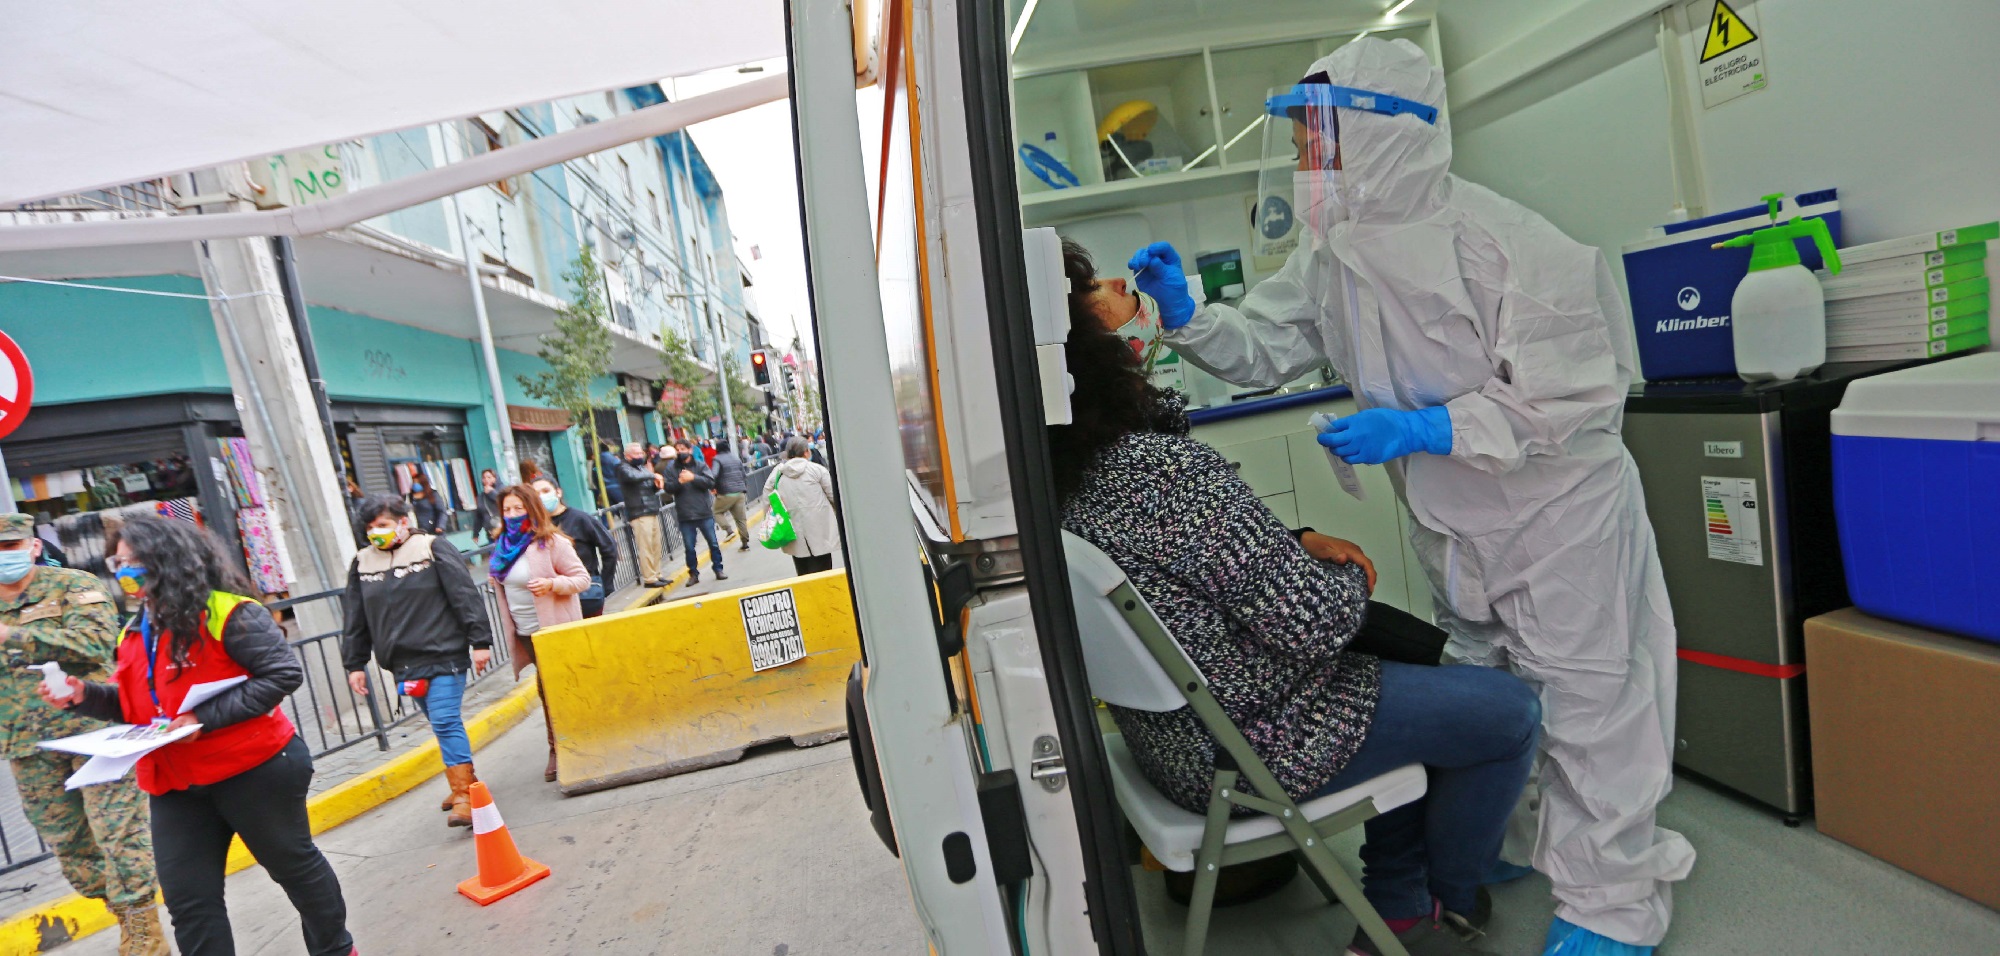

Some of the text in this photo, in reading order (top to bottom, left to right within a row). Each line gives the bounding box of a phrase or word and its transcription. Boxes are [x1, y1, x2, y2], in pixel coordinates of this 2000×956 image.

[1704, 58, 1760, 86] ELECTRICIDAD
[1714, 55, 1747, 73] PELIGRO
[1655, 315, 1730, 333] Klimber
[1708, 444, 1735, 455] Libero
[743, 591, 792, 618] COMPRO
[747, 609, 795, 635] VEHICULOS
[780, 634, 802, 661] 7197
